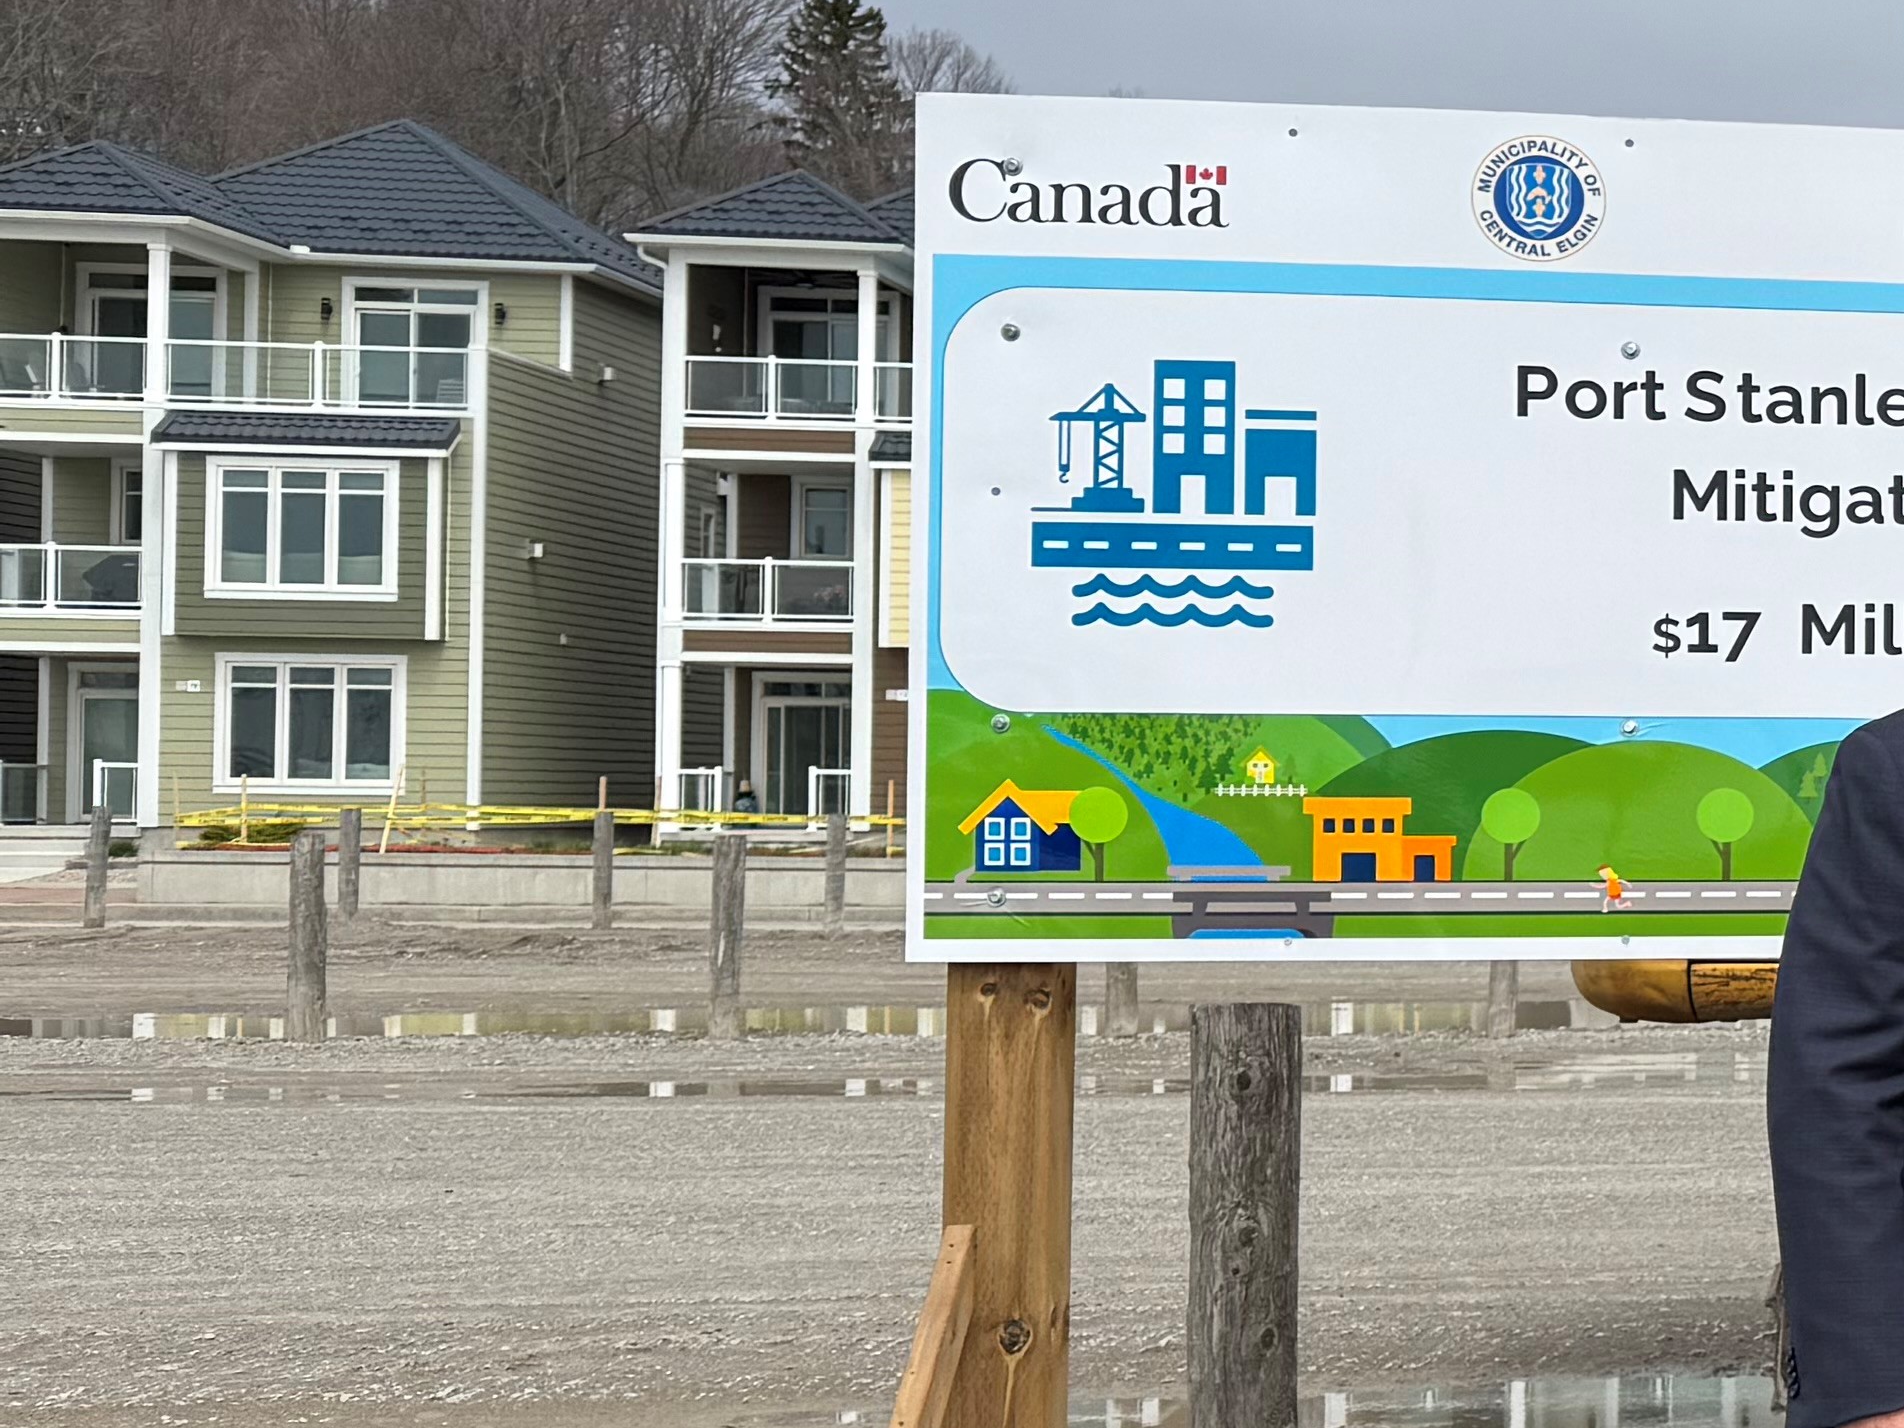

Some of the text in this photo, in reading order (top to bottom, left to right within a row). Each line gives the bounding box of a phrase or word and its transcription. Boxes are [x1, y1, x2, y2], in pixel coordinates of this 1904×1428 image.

[949, 158, 1230, 228] Canada
[1477, 140, 1601, 197] MUNICIPALITY OF
[1480, 209, 1599, 257] CENTRAL ELGIN
[1517, 365, 1667, 421] Port
[1652, 612, 1762, 663] $17
